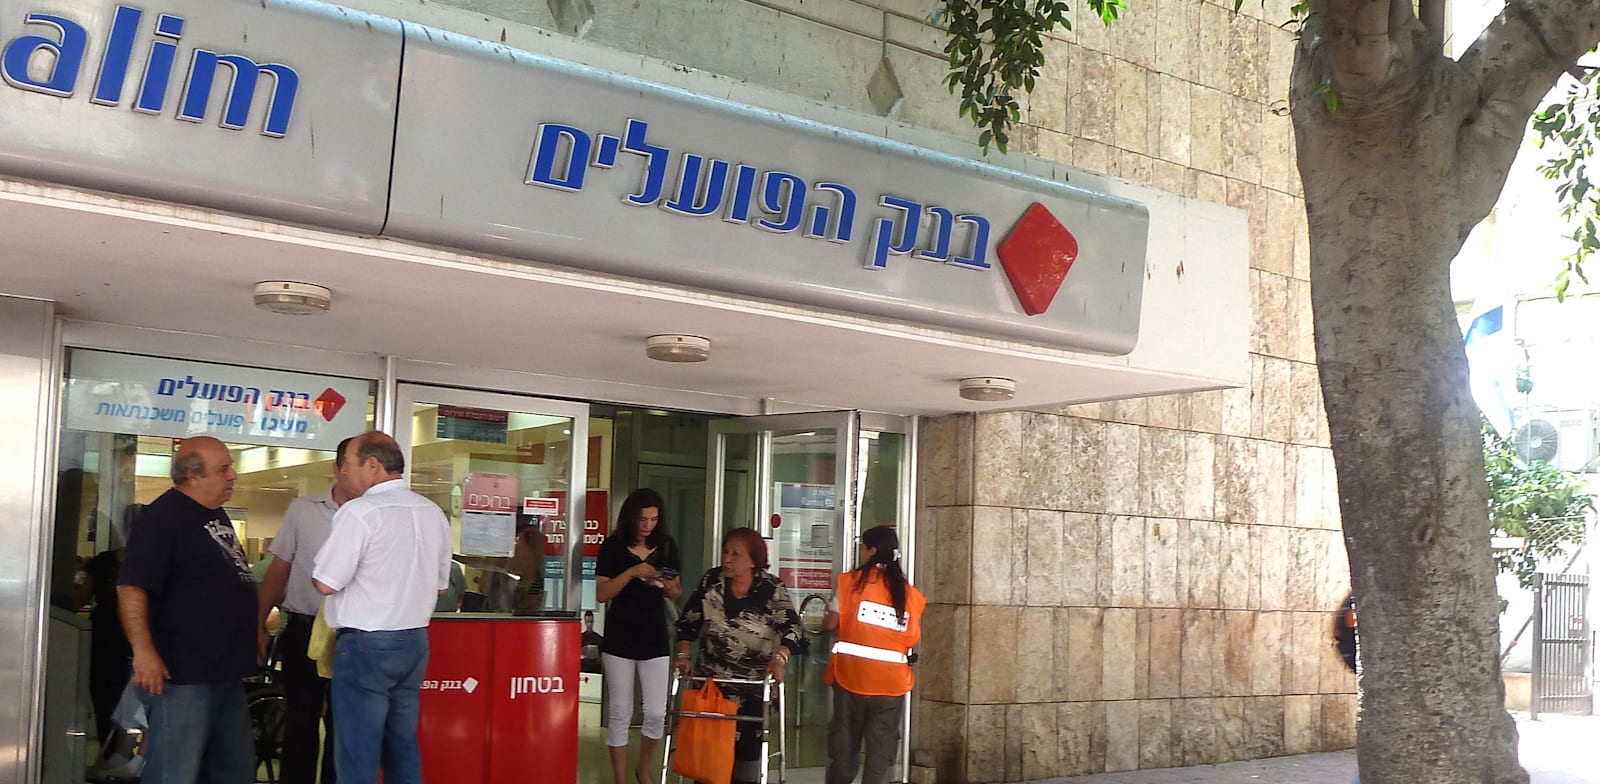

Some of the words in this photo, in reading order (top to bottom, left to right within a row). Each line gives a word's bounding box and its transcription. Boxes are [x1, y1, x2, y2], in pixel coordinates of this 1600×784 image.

[1, 4, 299, 138] alim
[524, 118, 857, 243] הפועלים
[864, 194, 992, 270] בנק
[157, 375, 261, 404] הפועלים
[265, 389, 310, 411] בנק
[191, 409, 244, 428] פועלים
[468, 493, 511, 509] ברוכים
[420, 680, 439, 689] הפ
[440, 680, 462, 692] בנק
[510, 676, 565, 699] בטחון
